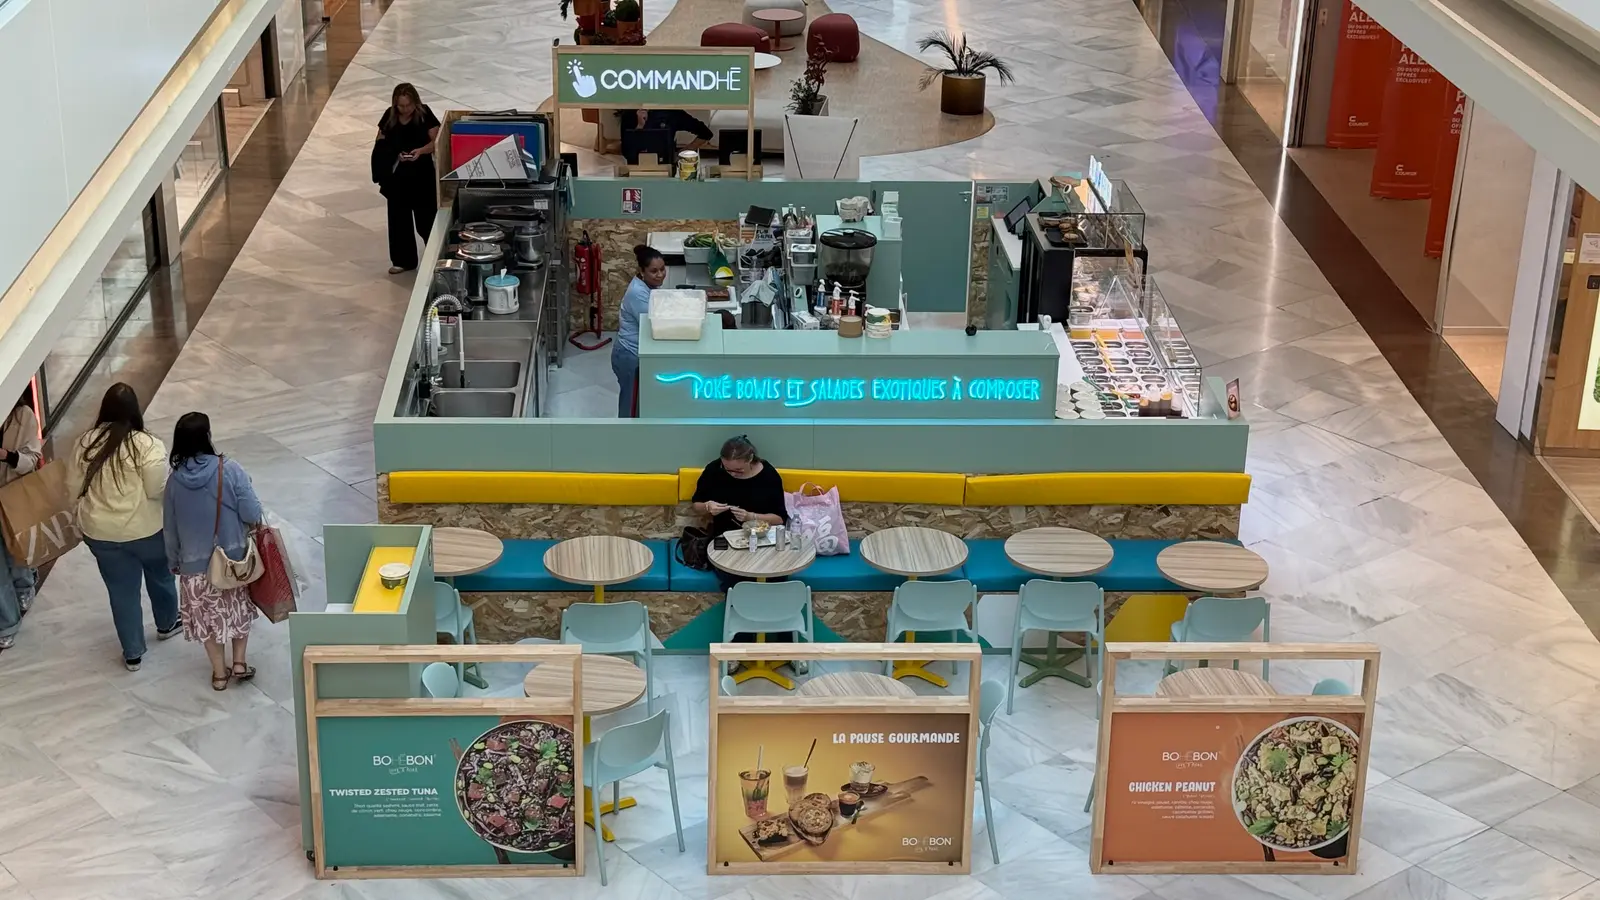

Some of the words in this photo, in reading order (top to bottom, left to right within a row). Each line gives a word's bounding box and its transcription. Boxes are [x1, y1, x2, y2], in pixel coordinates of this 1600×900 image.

[736, 379, 781, 400] BOWLS
[784, 378, 866, 407] SALADES
[787, 379, 804, 400] ET
[872, 378, 948, 401] EXOTIQUES
[952, 375, 962, 401] À
[968, 378, 1041, 401] COMPOSER
[15, 503, 83, 566] ZAR
[833, 733, 846, 744] LA
[850, 733, 885, 744] PAUSE
[888, 732, 960, 744] GOURMANDE
[329, 788, 372, 796] TWISTED
[374, 788, 410, 796] ZESTED
[1128, 781, 1173, 792] CHICKEN
[1175, 781, 1216, 792] PEANUT
